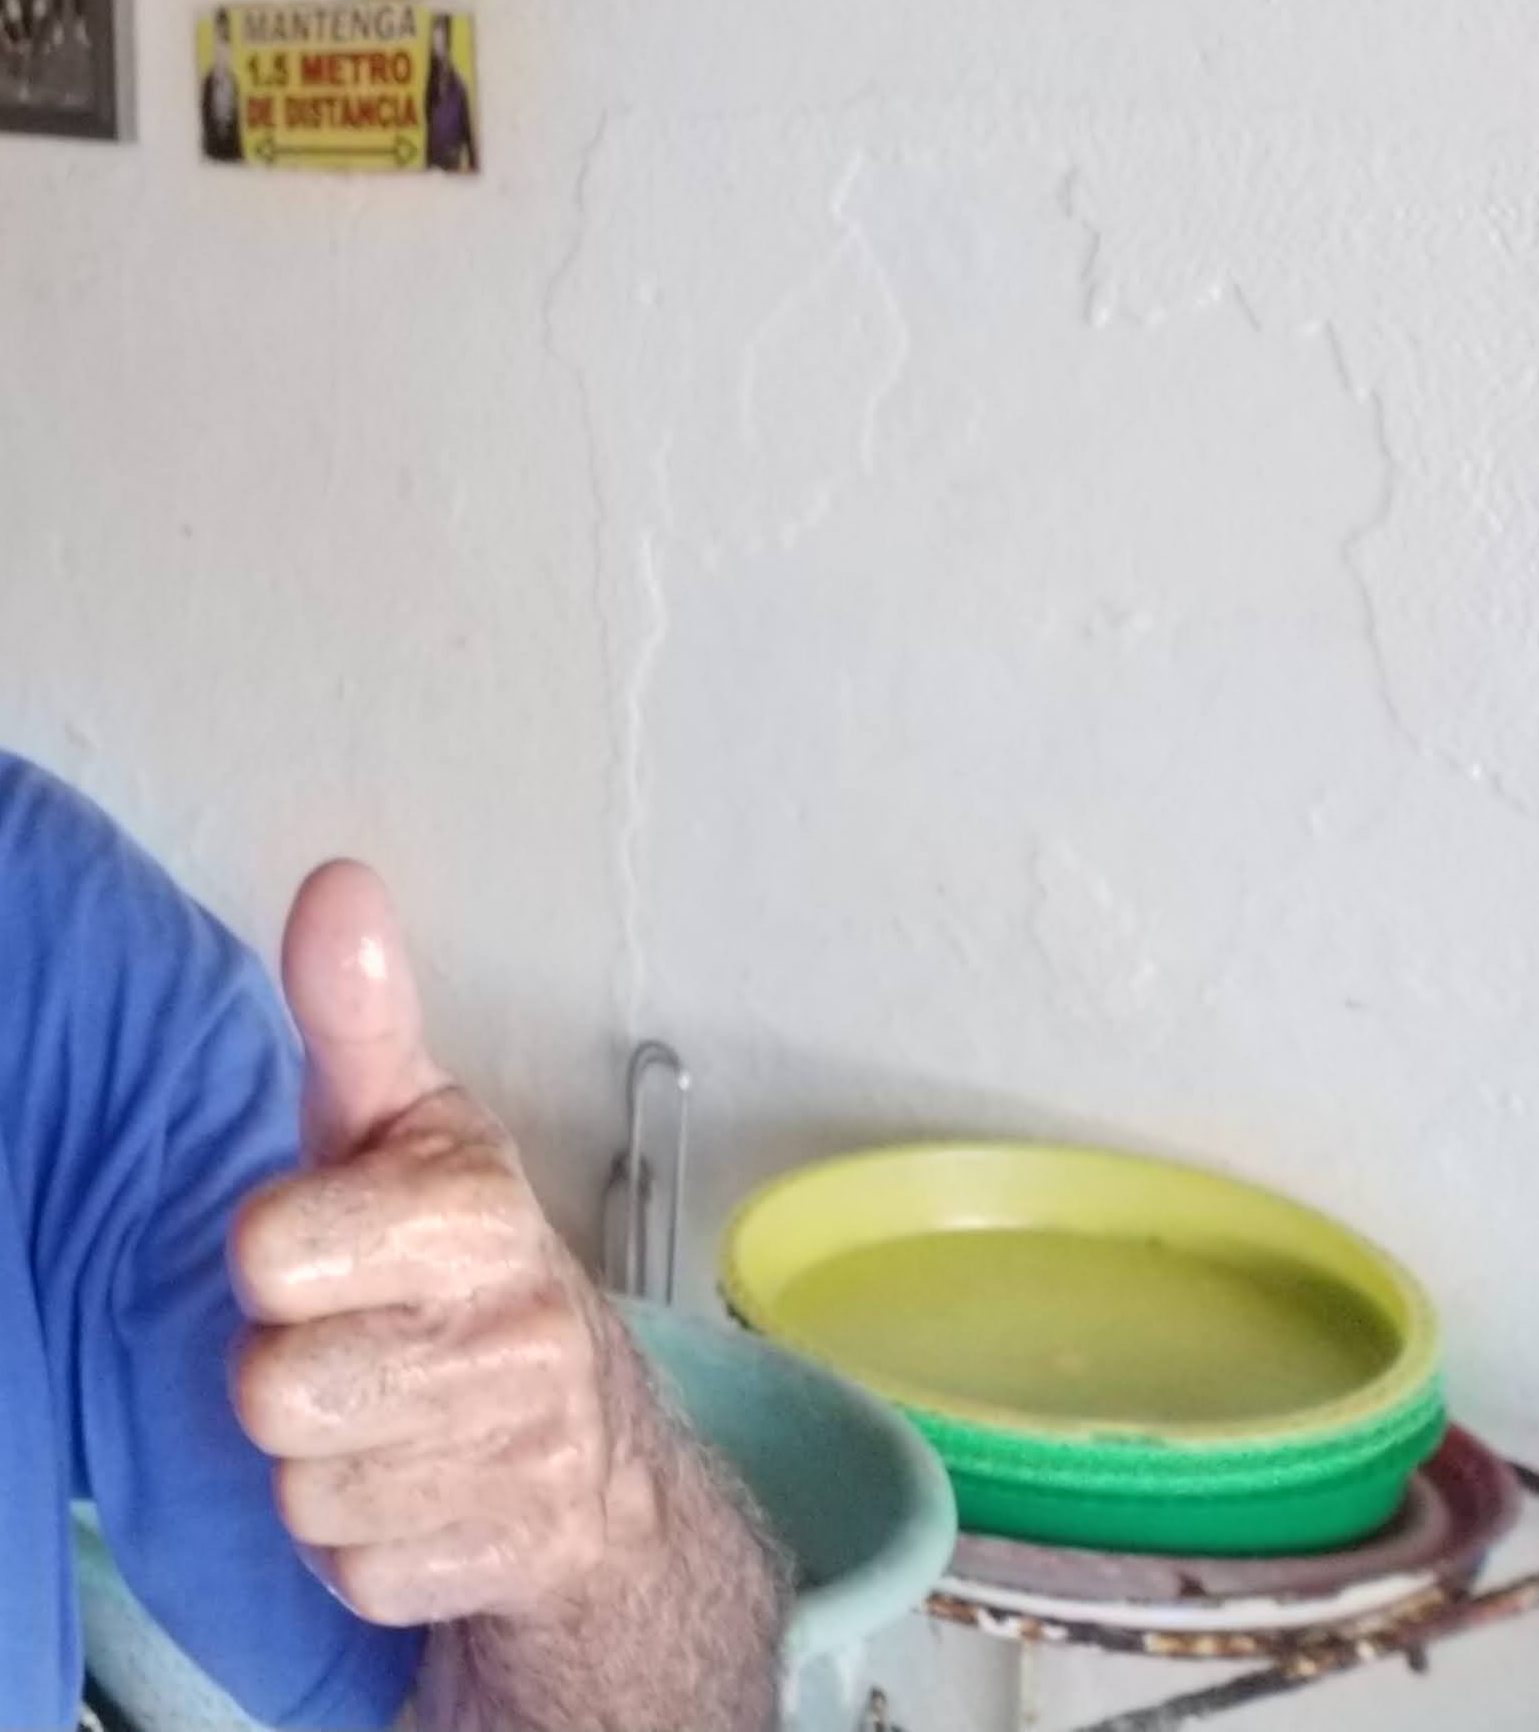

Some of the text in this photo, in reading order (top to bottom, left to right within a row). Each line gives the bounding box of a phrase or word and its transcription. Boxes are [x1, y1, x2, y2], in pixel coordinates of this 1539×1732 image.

[243, 6, 416, 42] MANTENGA
[301, 50, 413, 86] METRO
[247, 95, 418, 130] DE DISTANCIA
